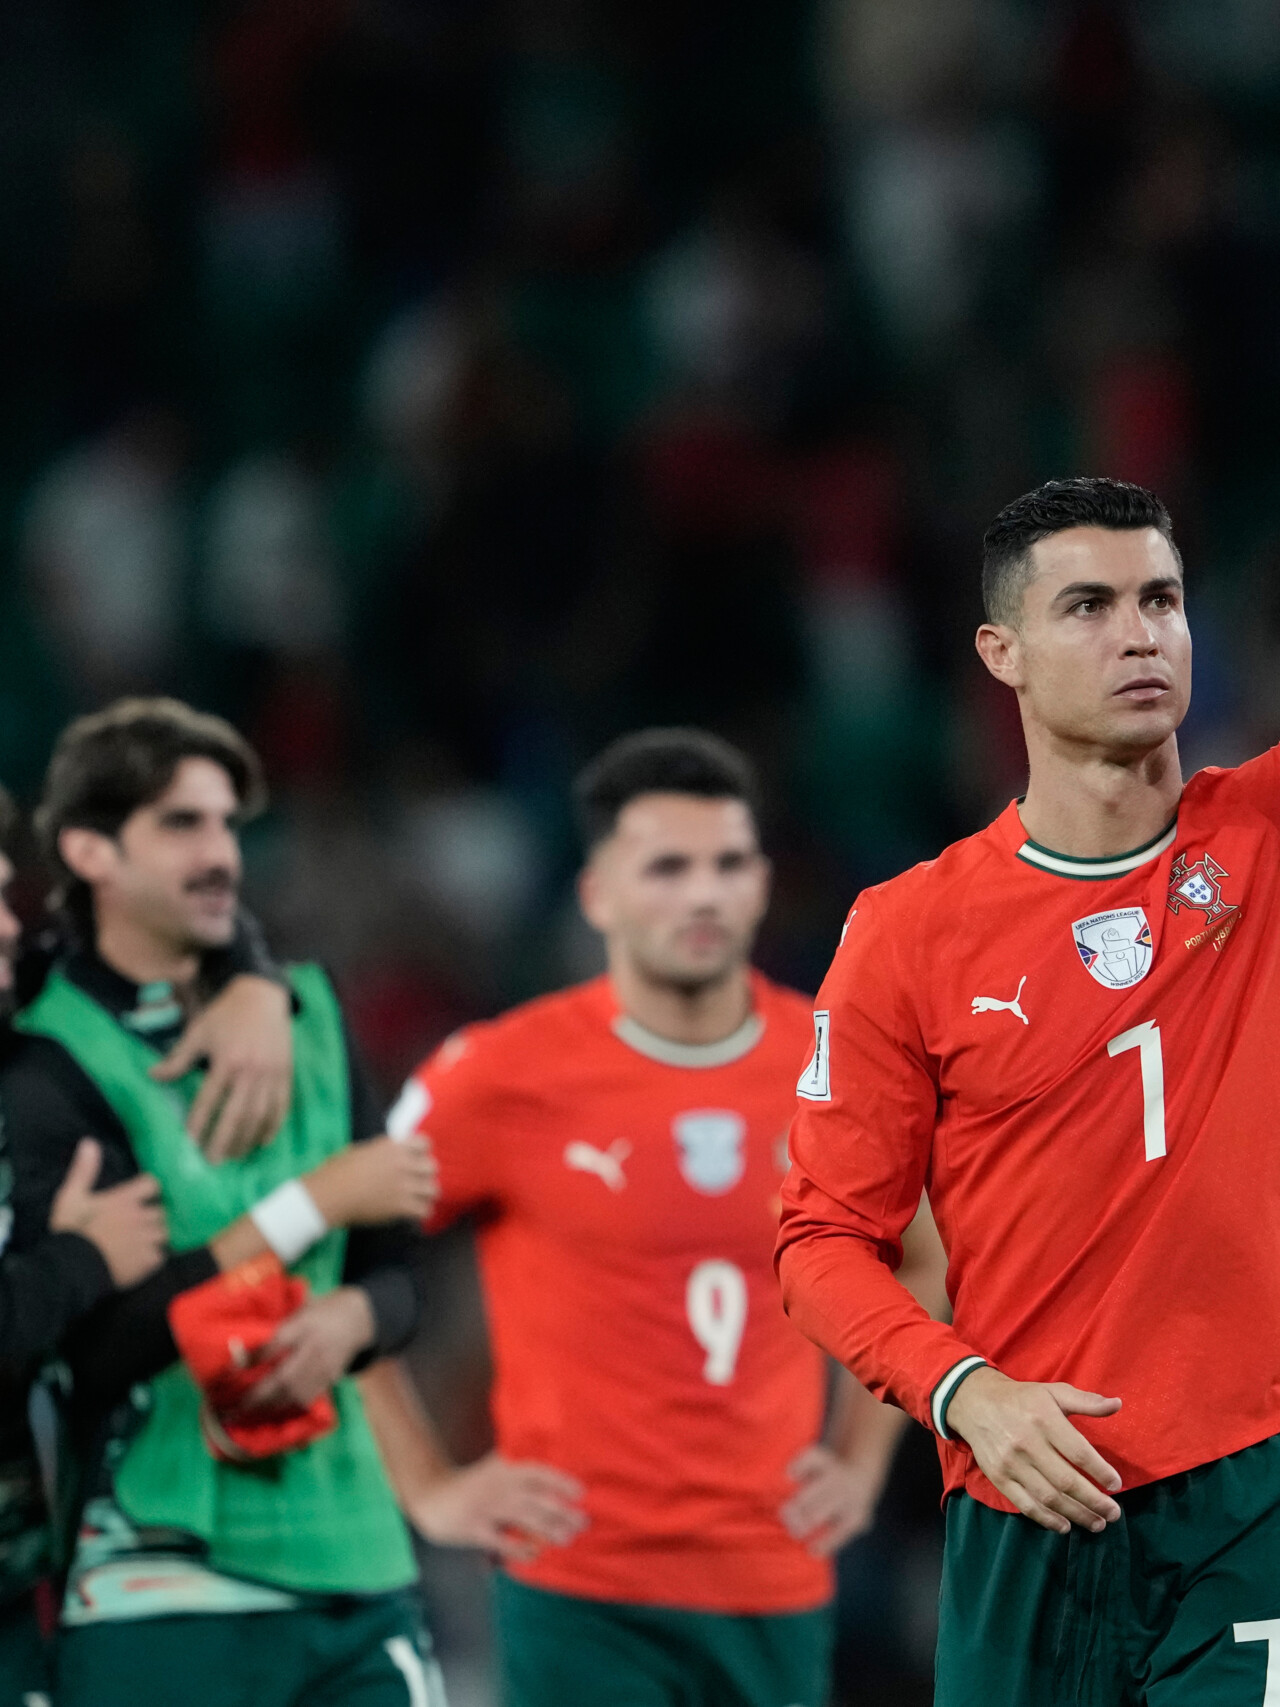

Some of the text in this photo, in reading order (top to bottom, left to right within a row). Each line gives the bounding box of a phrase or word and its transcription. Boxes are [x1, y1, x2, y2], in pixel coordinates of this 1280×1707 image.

[1075, 910, 1140, 930] UEFA NATIONS LEAGUE
[1107, 1018, 1167, 1162] 7
[685, 1259, 749, 1386] 9
